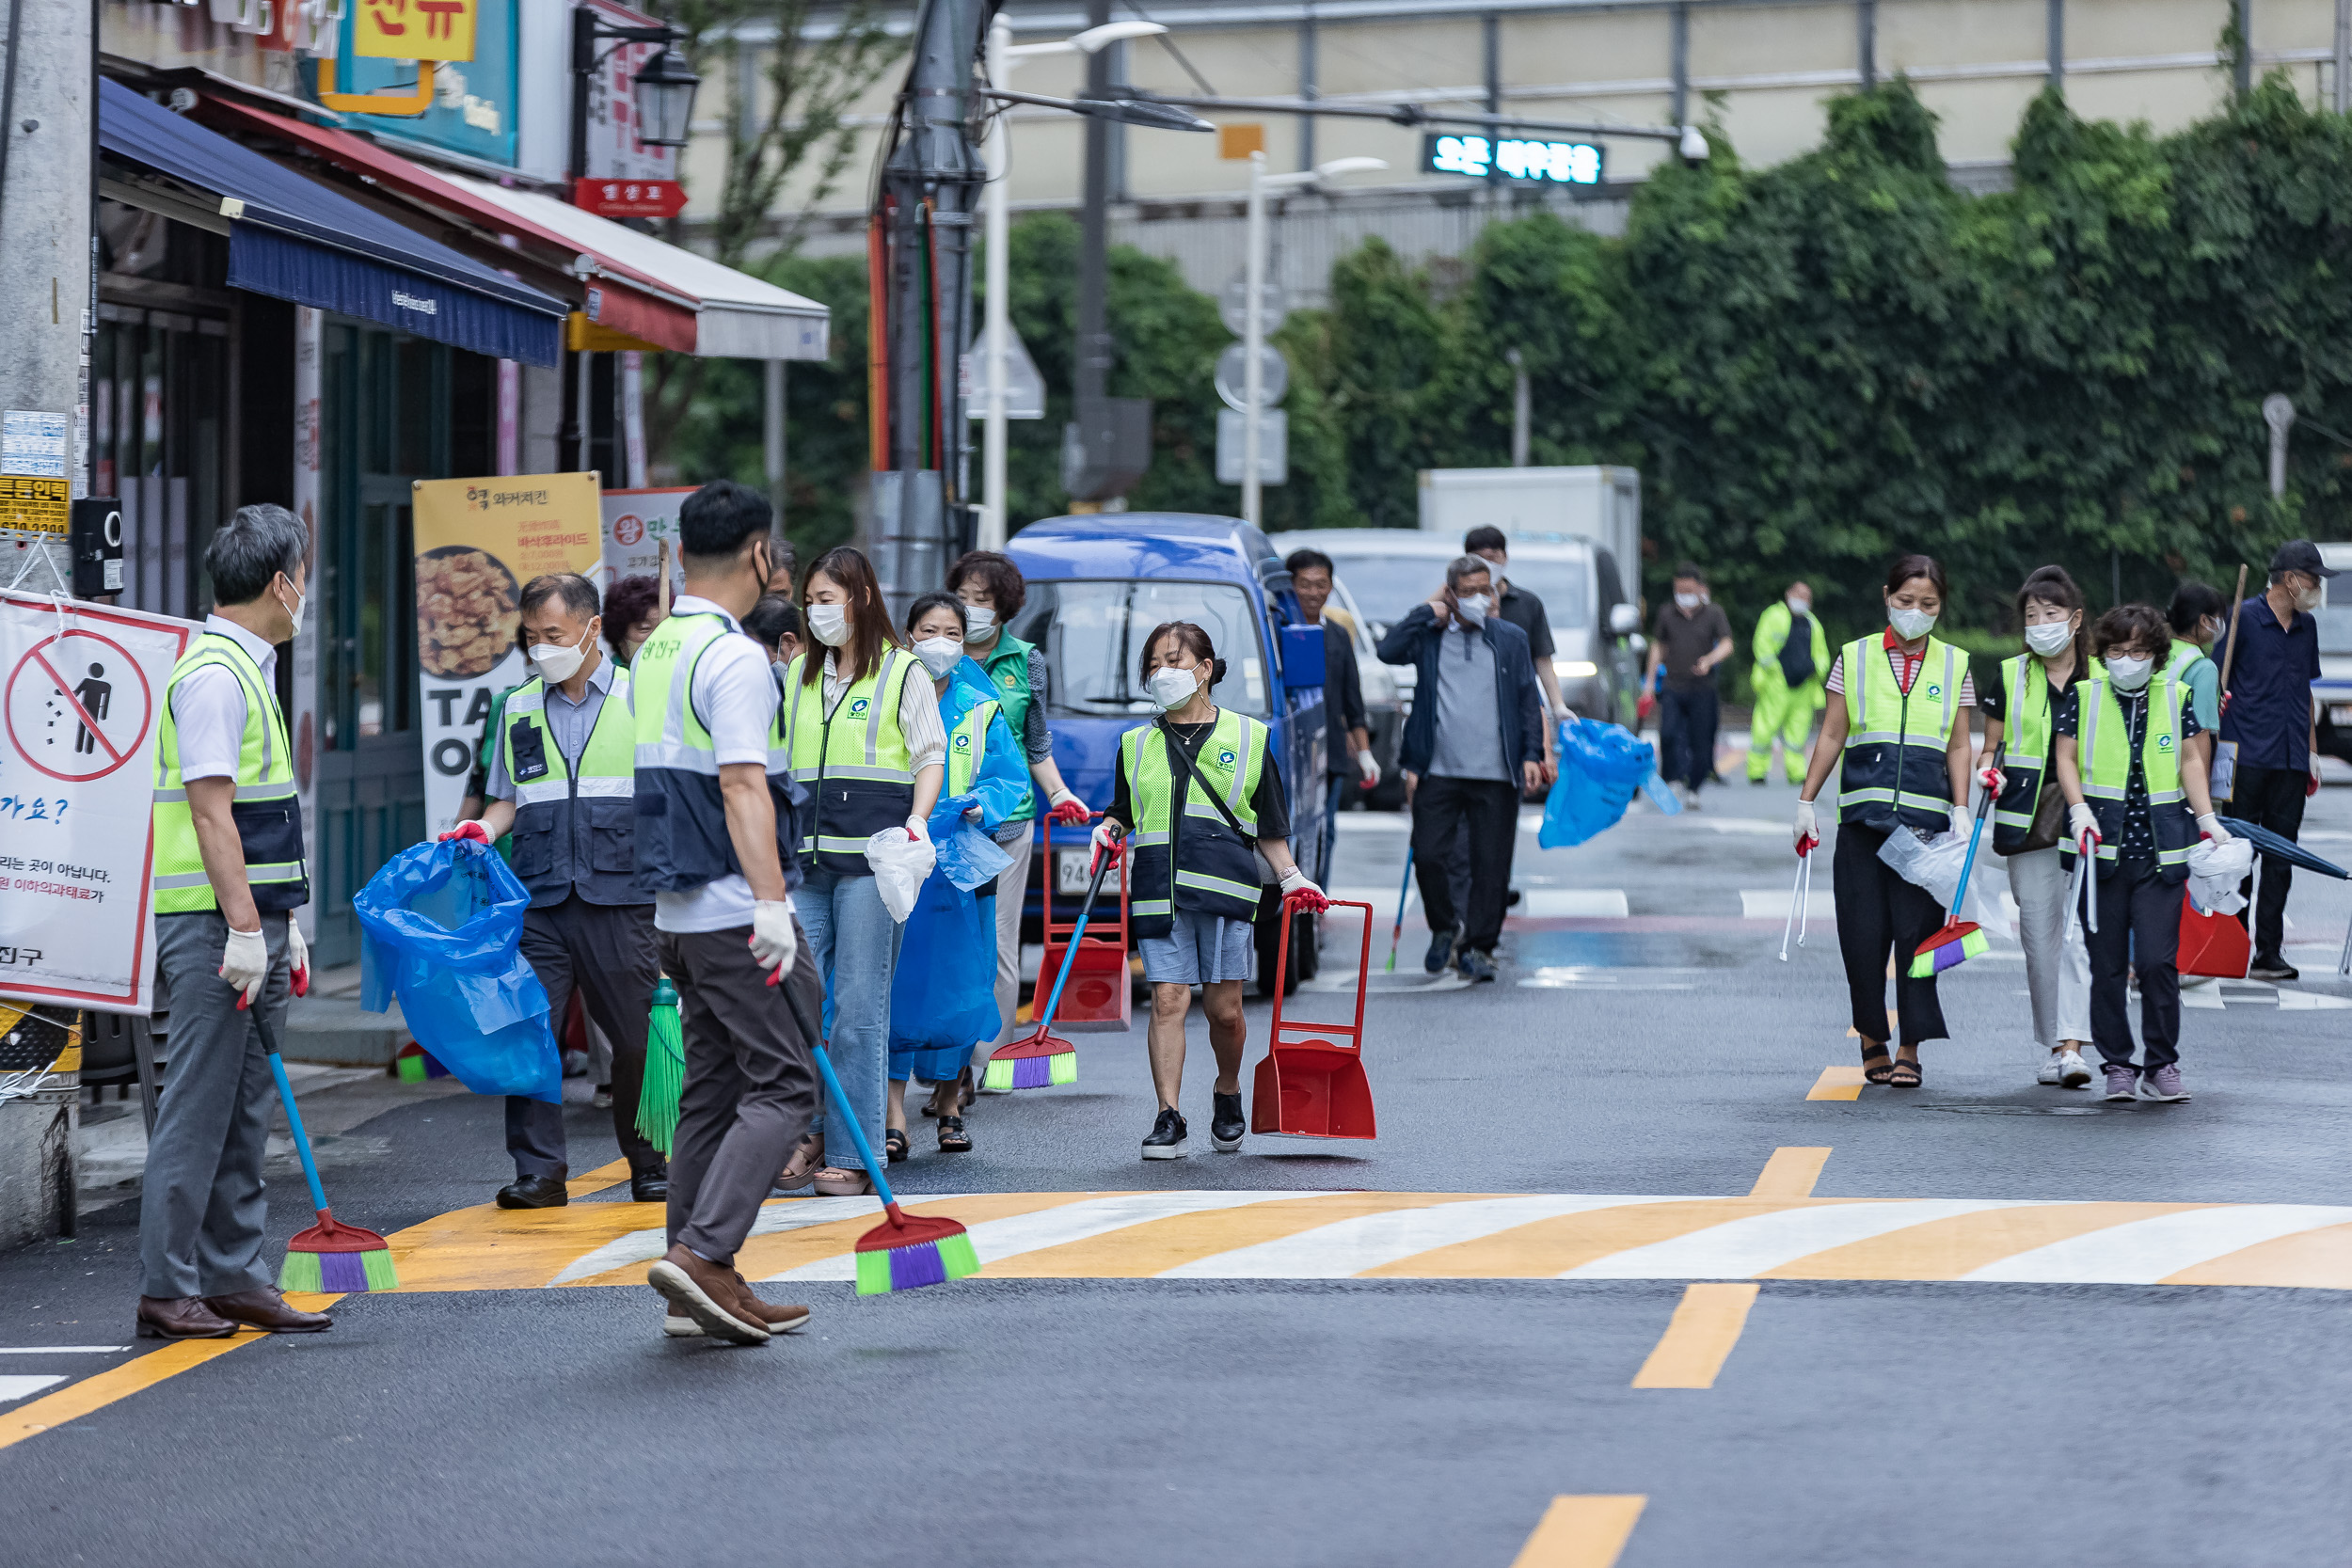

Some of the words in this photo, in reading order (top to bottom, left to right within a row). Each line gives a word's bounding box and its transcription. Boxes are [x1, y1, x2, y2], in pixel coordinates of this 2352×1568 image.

[643, 641, 681, 659] 광진구
[428, 686, 516, 727] TA
[432, 738, 475, 775] O
[29, 859, 53, 875] 곳이
[56, 863, 112, 884] 아닙니다.
[14, 879, 105, 904] 이하의과태료가
